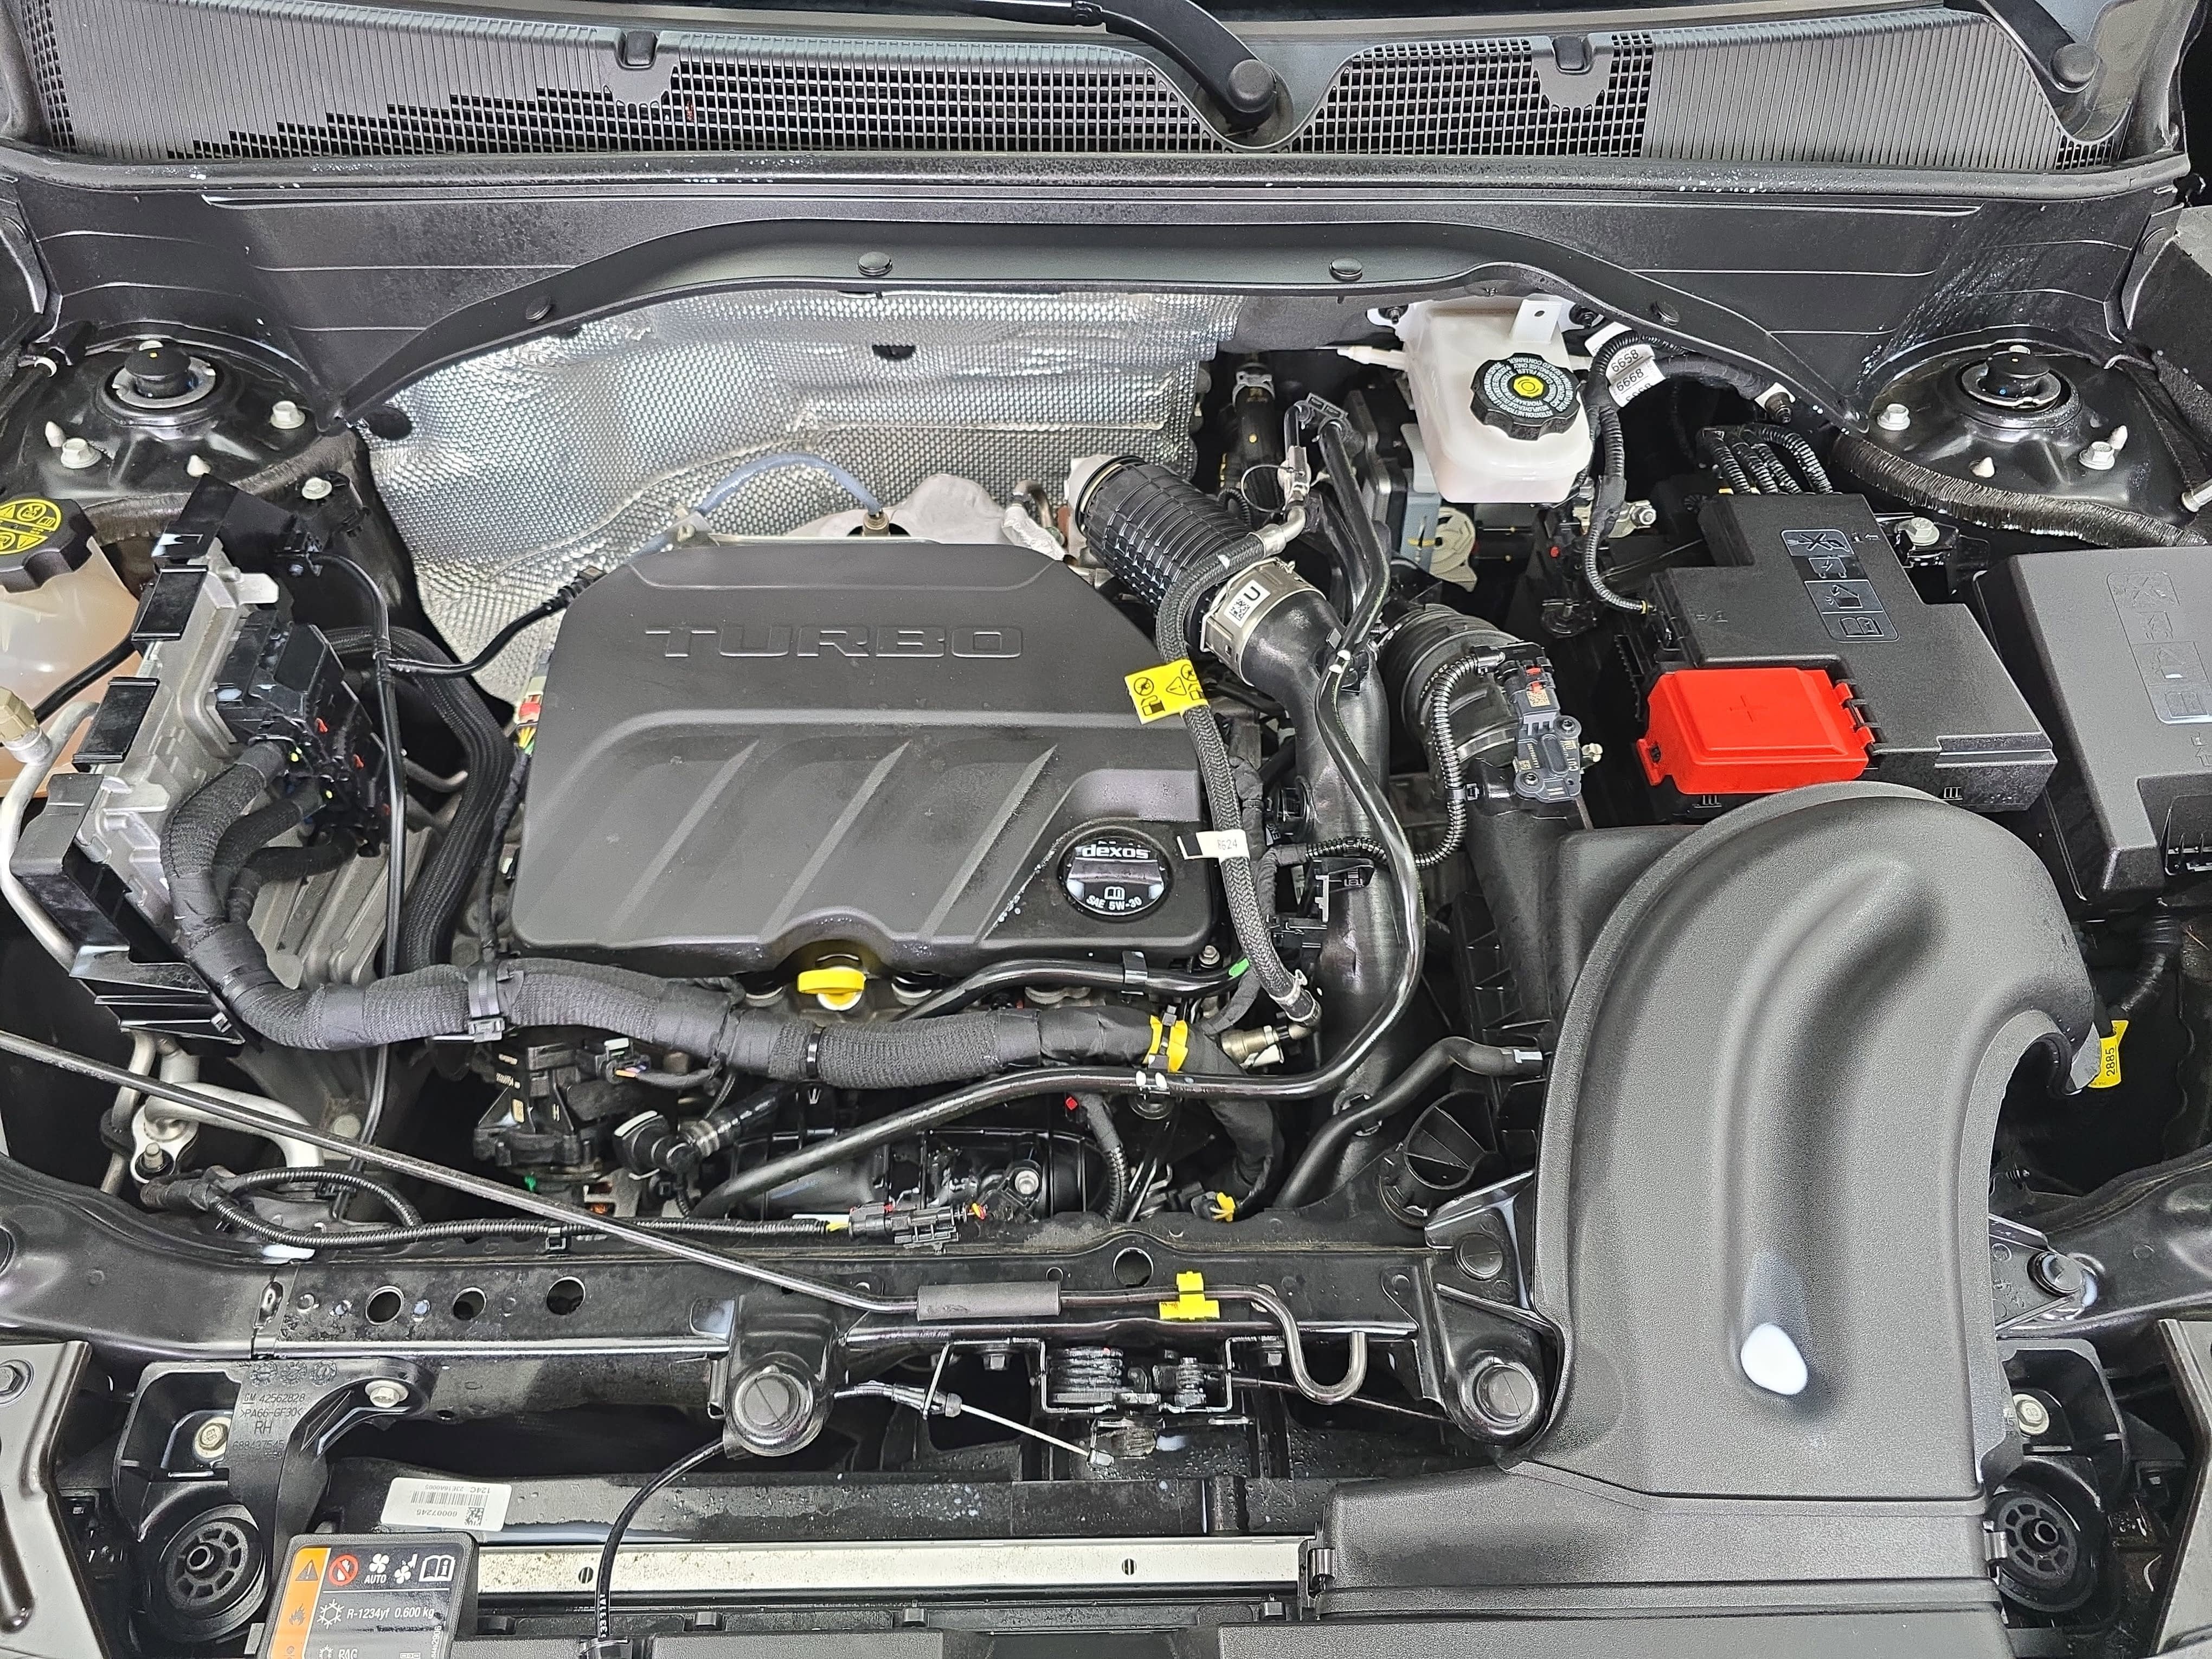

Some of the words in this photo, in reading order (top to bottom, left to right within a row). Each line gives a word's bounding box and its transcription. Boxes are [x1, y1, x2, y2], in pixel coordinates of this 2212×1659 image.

[1542, 362, 1564, 376] SEALED
[1537, 371, 1553, 384] CLEAN
[1243, 586, 1261, 601] U
[645, 626, 1023, 657] TURBO
[1082, 844, 1150, 859] dexos
[1085, 895, 1106, 909] SAE
[1108, 896, 1143, 911] 5W-30
[2105, 1047, 2115, 1077] 2885
[243, 1393, 256, 1403] GM
[259, 1393, 306, 1403] 42562828
[254, 1420, 273, 1435] RH
[364, 1574, 387, 1584] AUTO
[346, 1608, 390, 1620] R-1234yf
[394, 1607, 421, 1618] 0.600
[423, 1607, 435, 1619] kg
